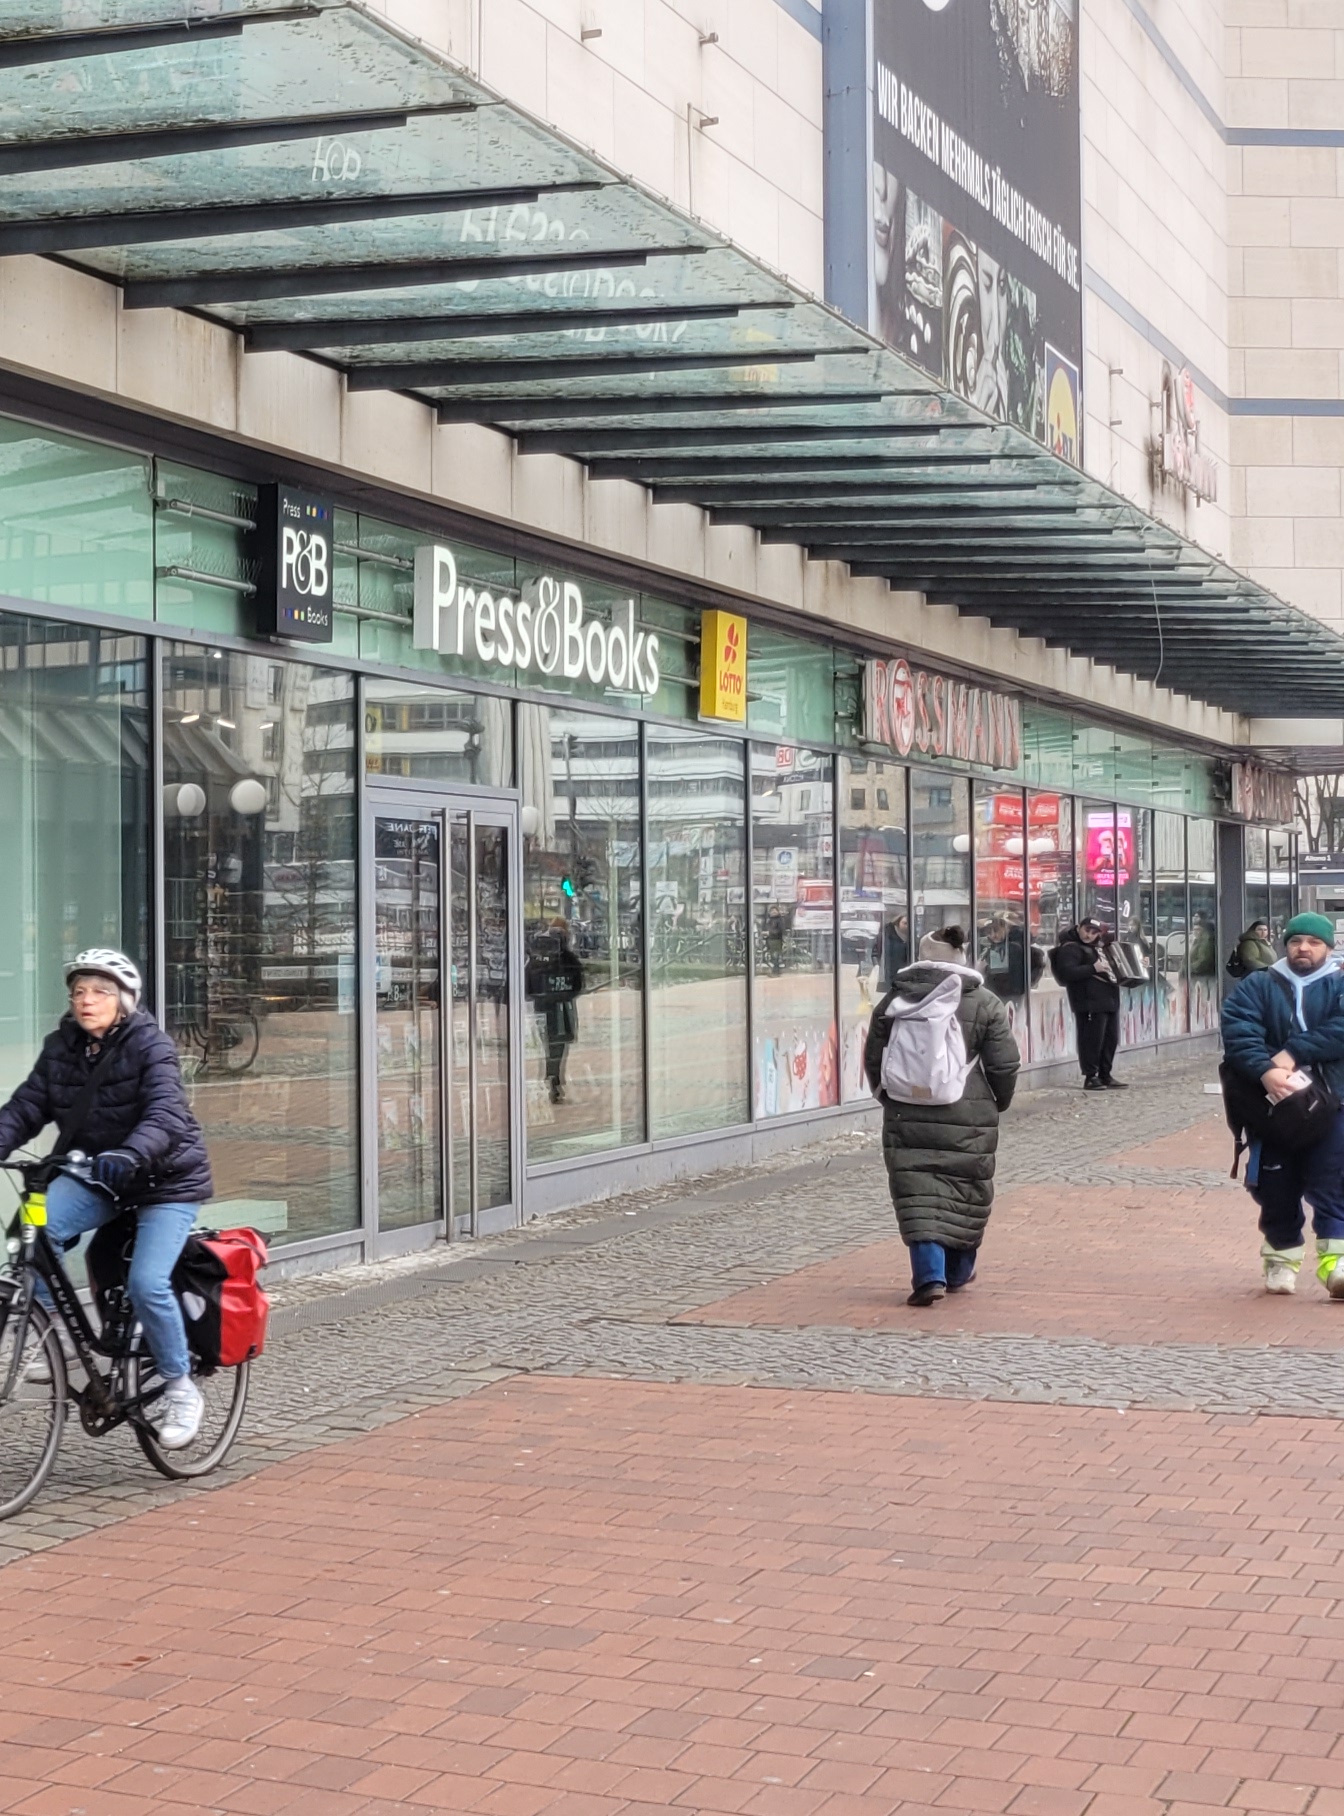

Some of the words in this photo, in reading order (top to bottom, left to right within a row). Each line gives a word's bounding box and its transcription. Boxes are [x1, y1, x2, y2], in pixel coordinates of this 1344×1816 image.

[877, 61, 898, 130] WIR
[900, 81, 939, 166] BACKEN
[941, 121, 990, 211] MEHRMALS
[991, 165, 1024, 242] TÄGLICH
[1025, 201, 1052, 266] FRISCH
[1053, 223, 1066, 280] FÜR
[1067, 241, 1080, 293] SIE.
[283, 498, 301, 519] Press
[282, 526, 328, 597] P&B
[307, 607, 329, 626] Books
[719, 670, 742, 695] LOTTO
